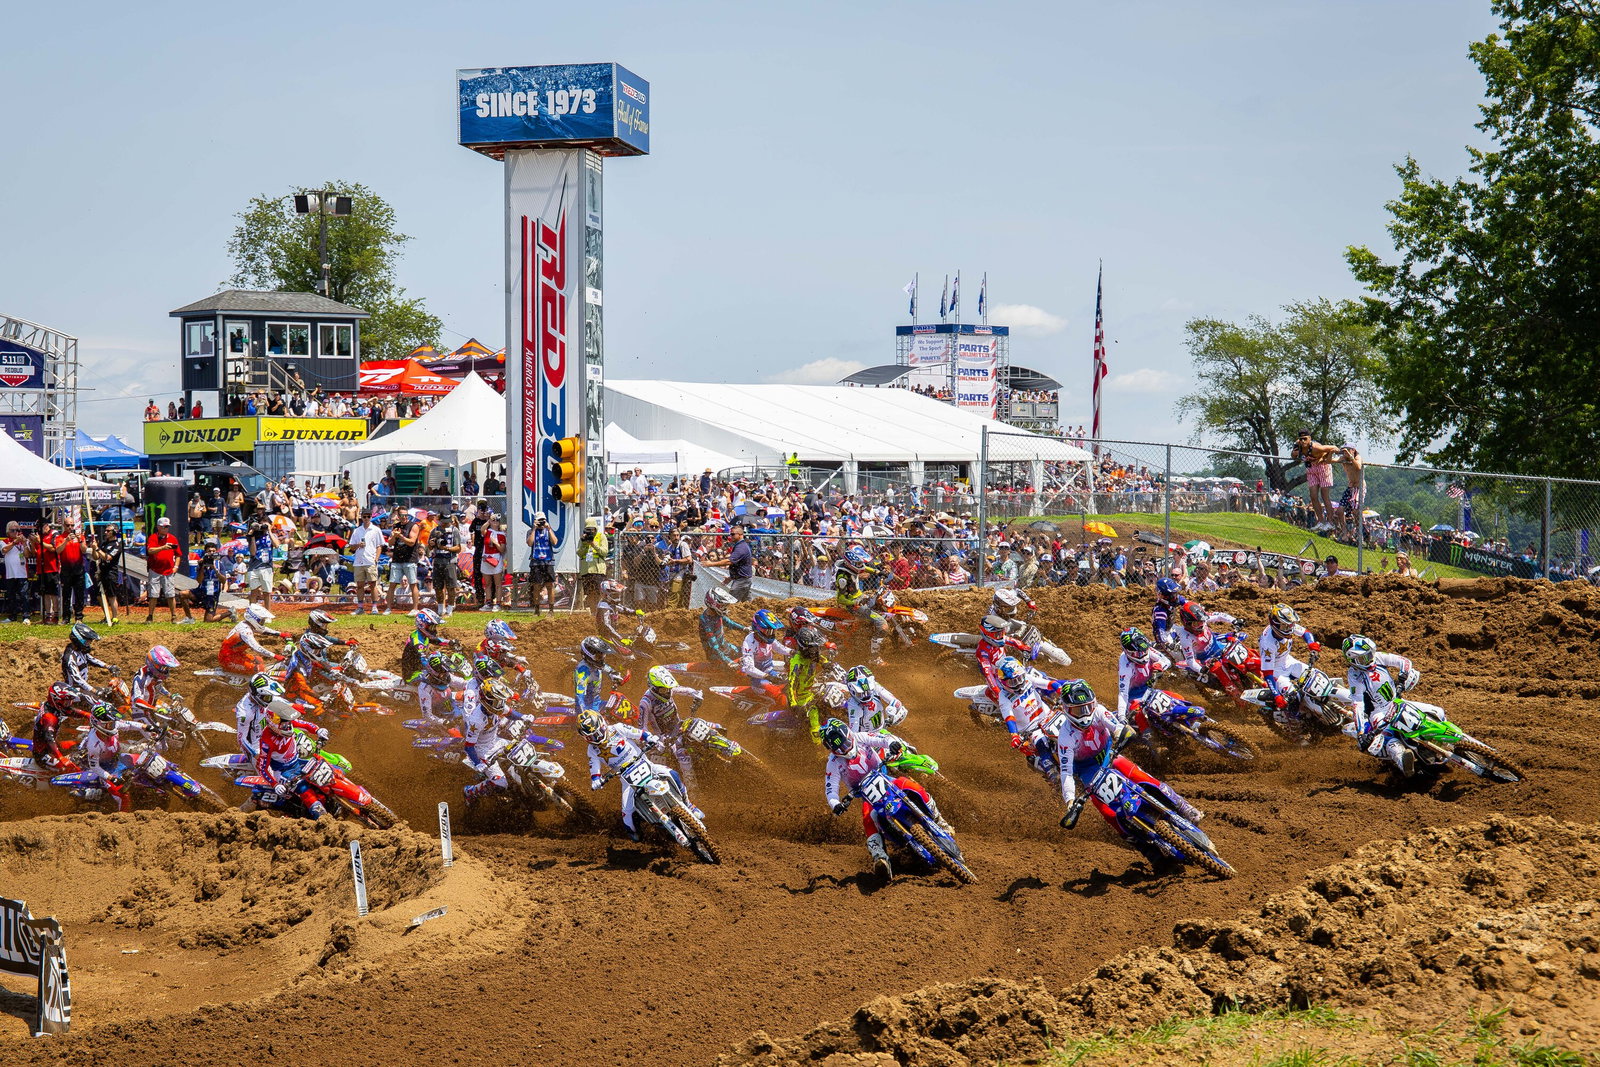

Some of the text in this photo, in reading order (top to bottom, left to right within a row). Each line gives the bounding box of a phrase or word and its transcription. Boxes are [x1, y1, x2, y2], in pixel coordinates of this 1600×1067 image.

[475, 88, 597, 118] SINCE 1973
[617, 99, 630, 124] Hall
[2, 355, 17, 365] 5.11
[959, 343, 990, 353] PARTS
[957, 368, 989, 377] PARTS
[957, 393, 989, 401] PARTS
[525, 348, 535, 484] AMERICA'S MOTOCROSS TRACK
[171, 427, 242, 444] DUNLOP
[280, 429, 364, 441] DUNLOP
[1464, 551, 1513, 572] MONSTER
[1228, 641, 1248, 665] 73
[1310, 673, 1330, 697] 58
[1151, 692, 1172, 714] 25
[1396, 704, 1423, 733] 141
[296, 734, 313, 758] 35
[514, 742, 534, 766] 34
[18, 775, 34, 787] 42
[313, 761, 333, 787] 29
[629, 762, 651, 785] 59
[261, 791, 279, 803] 29
[864, 775, 887, 802] 37
[1098, 772, 1124, 804] 82
[354, 859, 364, 884] UFO
